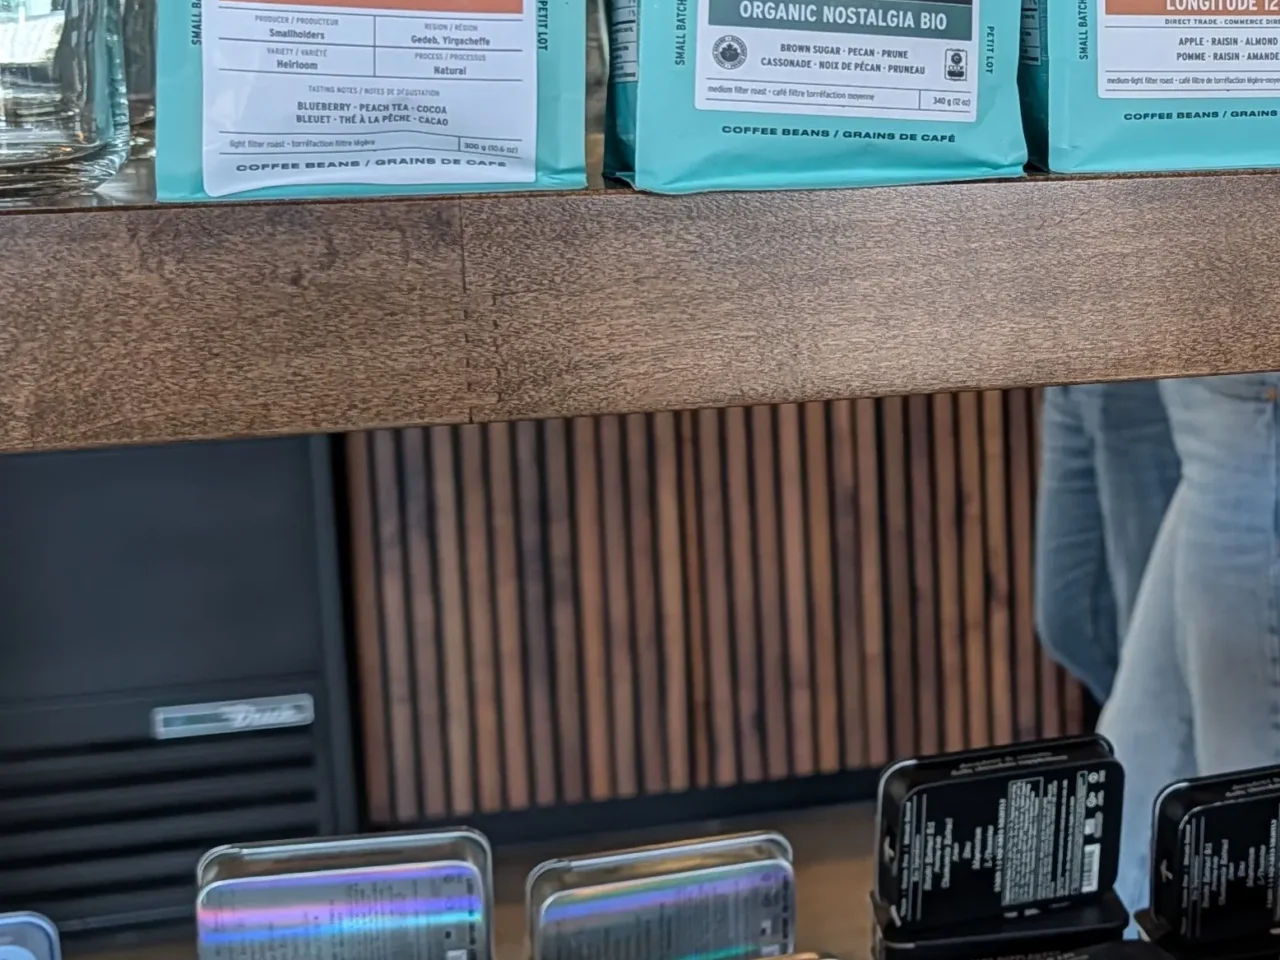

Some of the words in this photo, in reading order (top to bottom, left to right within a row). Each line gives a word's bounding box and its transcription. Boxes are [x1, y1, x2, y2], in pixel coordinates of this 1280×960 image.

[538, 0, 548, 30] PETIT
[676, 0, 688, 31] BATCH
[740, 0, 817, 22] ORGANIC
[823, 6, 915, 28] NOSTALGIA
[920, 12, 948, 30] BIO
[269, 29, 325, 40] Smallholders
[537, 32, 548, 51] LOT
[986, 26, 995, 53] PETIT
[1178, 37, 1204, 46] APPLE
[1211, 37, 1238, 46] RAISIN
[1245, 37, 1279, 46] ALMOND
[675, 34, 686, 66] SMALL
[780, 44, 811, 54] BROWN
[813, 45, 841, 56] SUGAR
[848, 48, 875, 57] PECAN
[882, 50, 909, 59] PRUNE
[1078, 30, 1089, 60] SMALL
[1177, 52, 1206, 61] POMME
[1213, 52, 1240, 61] RAISIN
[1247, 52, 1280, 61] AMANDE
[277, 60, 318, 70] Heirloom
[434, 66, 467, 76] Natural
[761, 57, 812, 68] CASSONADE
[819, 59, 840, 70] NOIX
[841, 61, 852, 71] DE
[854, 60, 881, 72] PÉCAN
[888, 65, 926, 75] PRUNEAU
[985, 56, 994, 74] LOT
[297, 102, 352, 112] BLUEBERRY
[359, 103, 390, 112] PEACH
[391, 103, 409, 112] TEA
[416, 105, 447, 114] COCOA
[1177, 111, 1219, 119] BEANS
[1230, 110, 1278, 118] GRAINS
[296, 115, 330, 124] BLEUET
[339, 113, 357, 124] THÉ
[368, 116, 380, 124] LA
[382, 112, 411, 123] PÊCHE
[418, 117, 449, 126] CACAO
[722, 126, 778, 136] COFFEE
[782, 128, 830, 138] BEANS
[843, 131, 896, 140] GRAINS
[900, 133, 918, 141] DE
[921, 132, 956, 143] CAFÉ
[236, 163, 300, 172] COFFEE
[305, 160, 360, 169] BEANS
[375, 157, 436, 166] GRAINS
